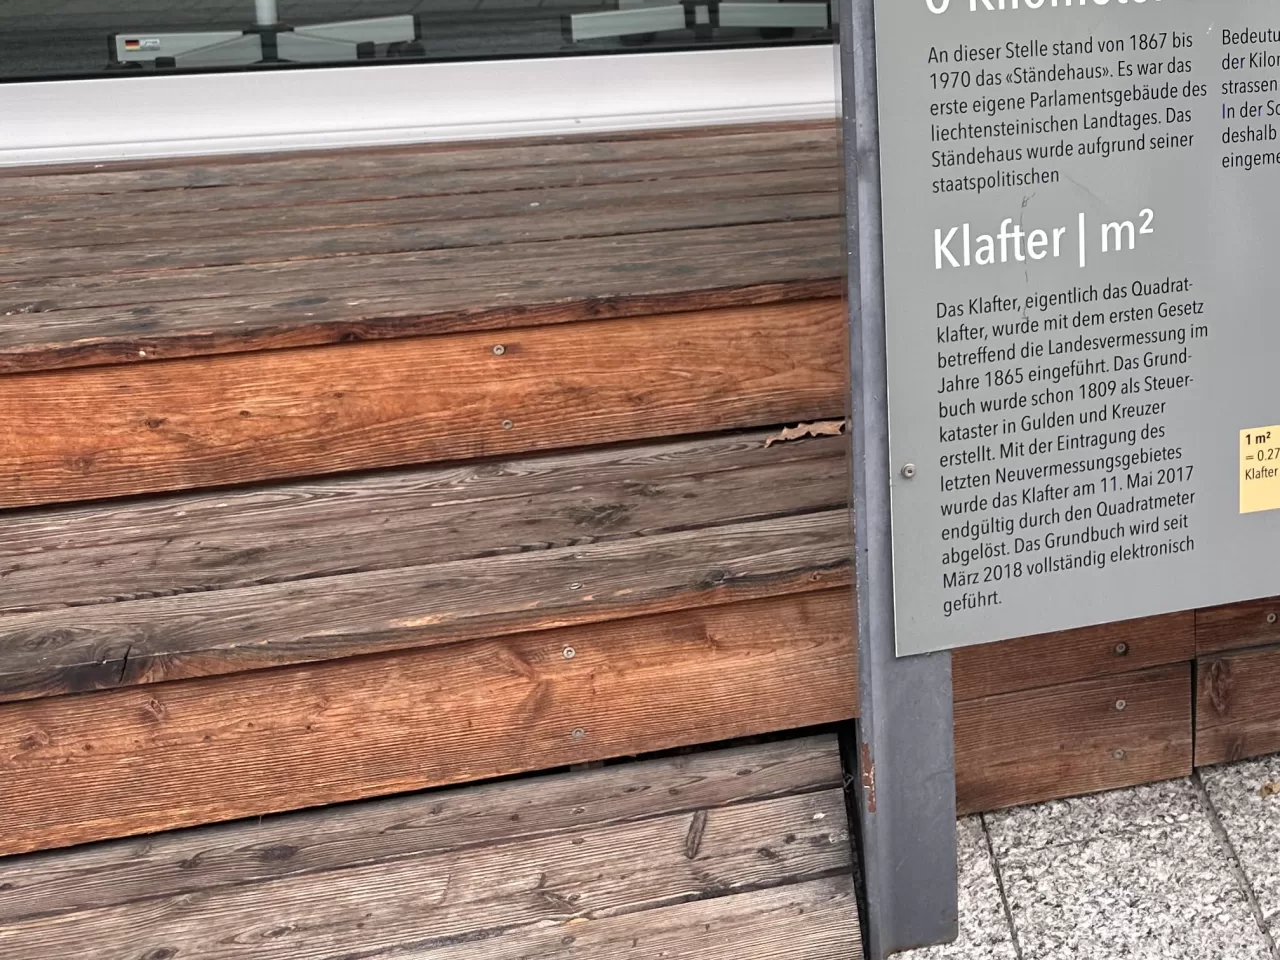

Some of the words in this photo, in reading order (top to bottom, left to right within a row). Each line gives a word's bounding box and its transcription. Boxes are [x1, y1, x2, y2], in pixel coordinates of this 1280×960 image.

[927, 46, 949, 64] An
[953, 43, 1002, 63] dieser
[1005, 39, 1048, 59] Stelle
[1052, 35, 1093, 56] stand
[1097, 39, 1124, 53] von
[1129, 32, 1168, 51] 1867
[1172, 31, 1193, 49] bis
[1221, 52, 1246, 71] der
[929, 70, 971, 90] 1970
[975, 68, 1002, 87] das
[1118, 60, 1133, 77] Es
[1136, 62, 1164, 76] war
[1167, 56, 1192, 74] das
[1221, 79, 1278, 95] strassen
[930, 99, 968, 116] erste
[972, 95, 1026, 117] eigene
[1030, 81, 1178, 109] Parlamentsgebäude
[1182, 80, 1208, 98] des
[1222, 103, 1235, 120] In
[1239, 100, 1264, 119] der
[931, 114, 1078, 142] liechtensteinischen
[1083, 110, 1162, 131] Landtages.
[1166, 107, 1192, 124] Das
[1221, 123, 1277, 144] deshalb
[931, 145, 1023, 168] Ständehaus
[1026, 139, 1074, 160] wurde
[1077, 132, 1145, 158] aufgrund
[1149, 132, 1194, 150] seiner
[932, 167, 1059, 195] staatspolitischen
[934, 217, 1066, 270] Klafter
[936, 302, 964, 319] Das
[968, 294, 1021, 315] Klafter,
[1023, 284, 1098, 312] eigentlich
[1102, 282, 1128, 300] das
[1131, 276, 1193, 297] Quadrat-
[937, 323, 988, 344] klafter,
[991, 316, 1039, 337] wurde
[1044, 313, 1069, 331] mit
[1072, 310, 1105, 328] dem
[1109, 307, 1153, 324] ersten
[1157, 300, 1204, 319] Gesetz
[937, 342, 1016, 369] betreffend
[1020, 340, 1044, 359] die
[1048, 328, 1186, 355] Landesvermessung
[1190, 323, 1208, 339] im
[937, 374, 980, 394] Jahre
[984, 367, 1024, 387] 1865
[1028, 358, 1110, 384] eingeführt.
[1114, 355, 1140, 372] Das
[1143, 346, 1192, 368] Grund-
[939, 397, 976, 419] buch
[980, 391, 1027, 413] wurde
[1031, 387, 1074, 407] schon
[1079, 380, 1117, 400] 1809
[1120, 376, 1141, 395] als
[1144, 375, 1194, 392] Steuer-
[939, 423, 999, 443] kataster
[1002, 418, 1016, 435] in
[1020, 410, 1075, 432] Gulden
[1079, 404, 1107, 425] und
[1112, 401, 1166, 420] Kreuzer
[1245, 433, 1251, 446] 1
[939, 444, 996, 468] erstellt.
[1000, 441, 1025, 459] Mit
[1028, 437, 1053, 456] der
[1057, 429, 1136, 452] Eintragung
[1140, 422, 1165, 440] des
[940, 473, 991, 492] letzten
[995, 446, 1182, 485] Neuvermessungsgebietes
[1245, 465, 1279, 481] Klafter
[940, 494, 988, 517] wurde
[992, 491, 1018, 509] das
[1021, 484, 1070, 506] Klafter
[1072, 482, 1096, 498] am
[1099, 476, 1123, 494] 11.
[1127, 471, 1153, 490] Mai
[1157, 465, 1194, 485] 2017
[941, 516, 1014, 541] endgültig
[1018, 507, 1060, 529] durch
[1064, 504, 1092, 523] den
[1096, 492, 1196, 517] Quadratmeter
[941, 541, 1010, 567] abgelöst.
[1014, 537, 1041, 554] Das
[1044, 521, 1125, 549] Grundbuch
[1129, 515, 1159, 536] wird
[1163, 513, 1189, 532] seit
[943, 570, 980, 589] März
[983, 561, 1023, 583] 2018
[1026, 549, 1106, 576] vollständig
[1110, 535, 1195, 563] elektronisch
[943, 590, 1002, 618] geführt.
